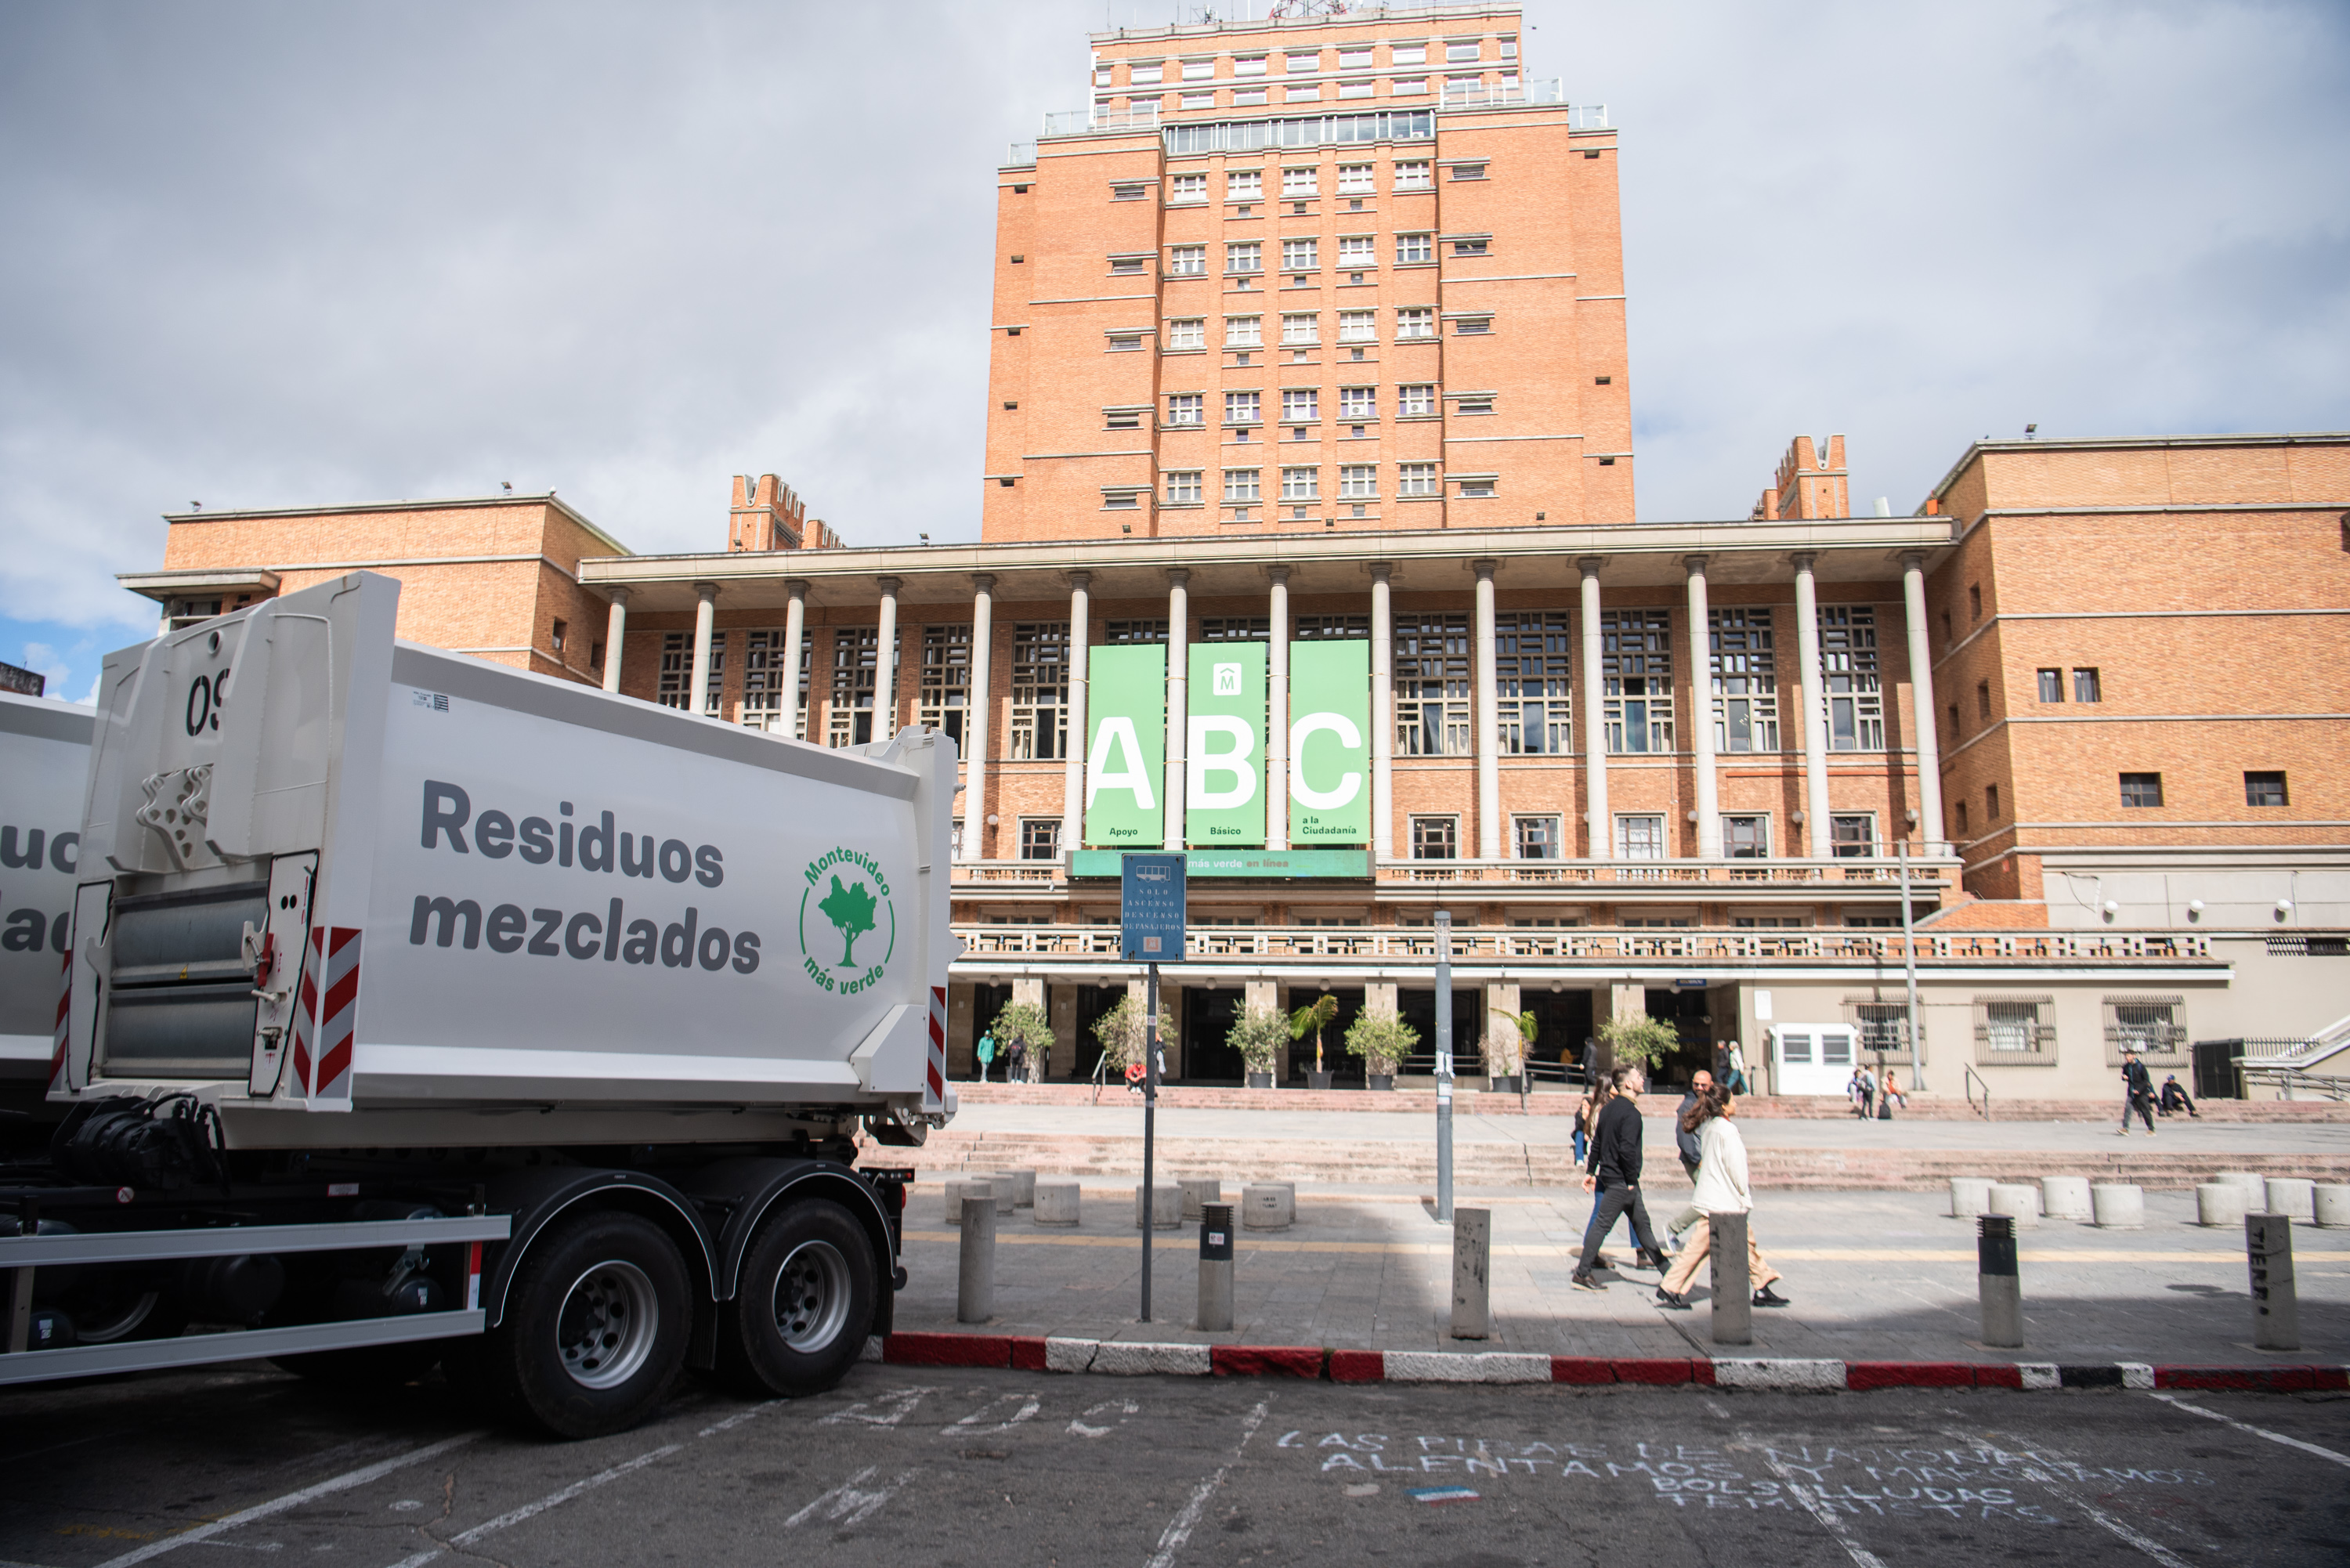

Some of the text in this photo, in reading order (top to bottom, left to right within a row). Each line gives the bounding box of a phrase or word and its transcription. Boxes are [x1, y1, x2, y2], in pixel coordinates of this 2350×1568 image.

[421, 779, 724, 888] Residuos
[1109, 827, 1138, 837] Apoyo
[1210, 826, 1242, 835] Básico
[1302, 826, 1357, 835] Ciudadanía
[804, 846, 890, 897] Montevideo
[1188, 858, 1210, 868] más
[1213, 858, 1243, 868] verde
[1263, 858, 1289, 868] línea
[410, 894, 761, 974] mezclados
[804, 956, 884, 995] más verde
[1276, 1430, 1389, 1452] LAS
[1321, 1453, 1744, 1480] ALENTAMOS
[1783, 1462, 1835, 1483] Y
